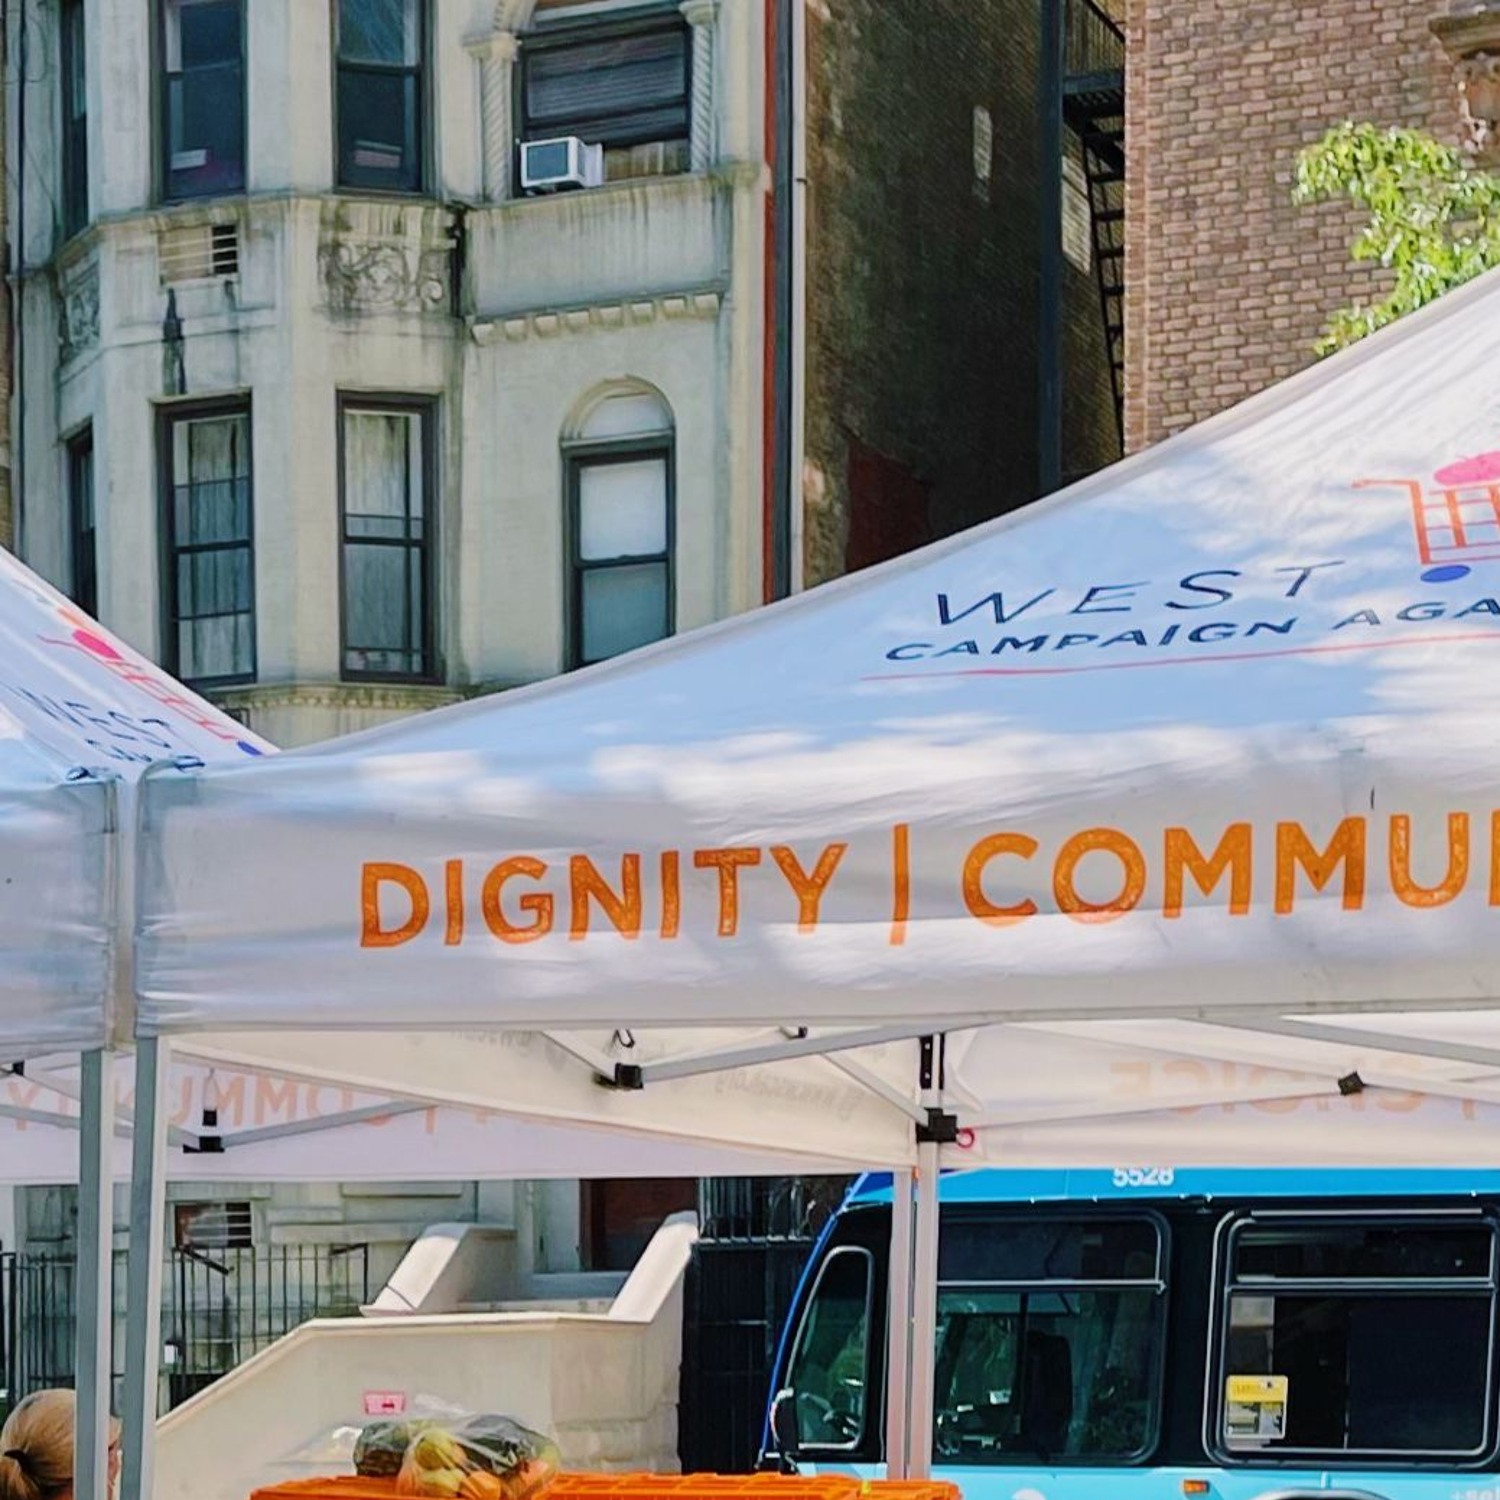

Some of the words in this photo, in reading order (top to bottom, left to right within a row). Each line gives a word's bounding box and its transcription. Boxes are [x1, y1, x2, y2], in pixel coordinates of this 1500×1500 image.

[936, 561, 1347, 626] WEST
[884, 617, 1299, 663] CAMPAIGN
[360, 842, 848, 948] DIGNITY
[1113, 1167, 1174, 1188] 5528
